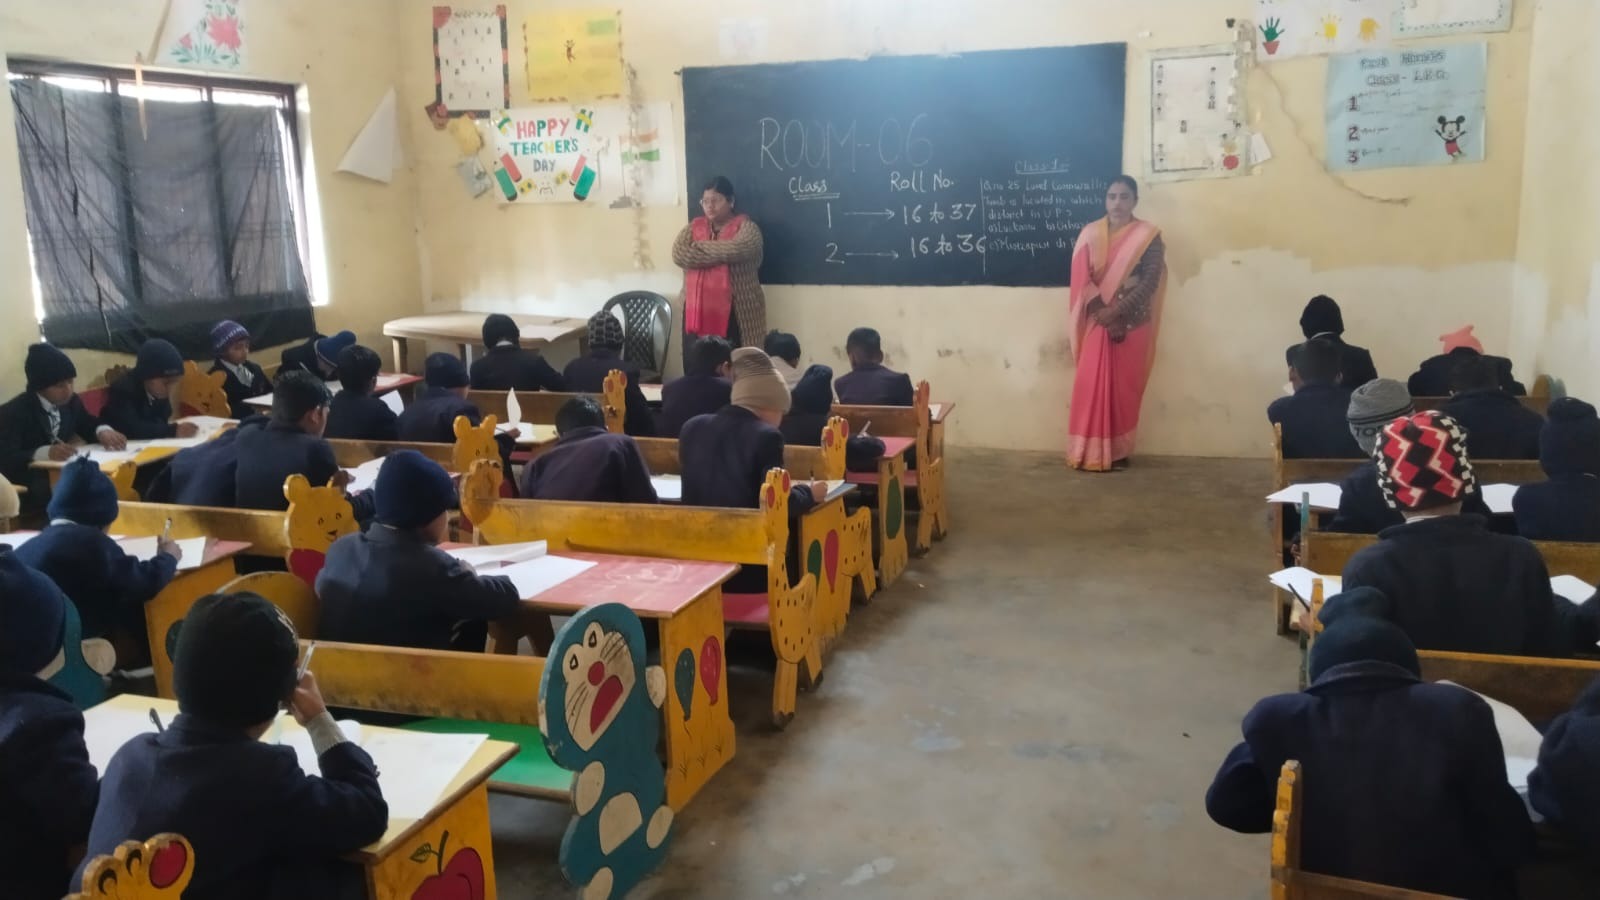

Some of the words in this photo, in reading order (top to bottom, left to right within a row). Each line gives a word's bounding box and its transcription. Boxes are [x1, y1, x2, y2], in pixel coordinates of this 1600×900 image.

[1347, 95, 1359, 111] 1
[516, 117, 570, 140] HAPPY
[1348, 125, 1359, 141] 2
[509, 136, 579, 156] TEACHER'S
[1347, 149, 1359, 163] 3
[533, 159, 556, 172] DAY
[788, 176, 828, 194] Class
[890, 170, 926, 193] Roll
[933, 168, 955, 192] No.
[1008, 179, 1020, 190] 25
[826, 202, 832, 229] 1
[903, 204, 922, 225] 16
[930, 202, 945, 224] to
[950, 203, 977, 221] 37
[825, 242, 845, 264] 2
[911, 237, 929, 258] 16
[934, 233, 953, 255] to
[956, 233, 987, 254] 36
